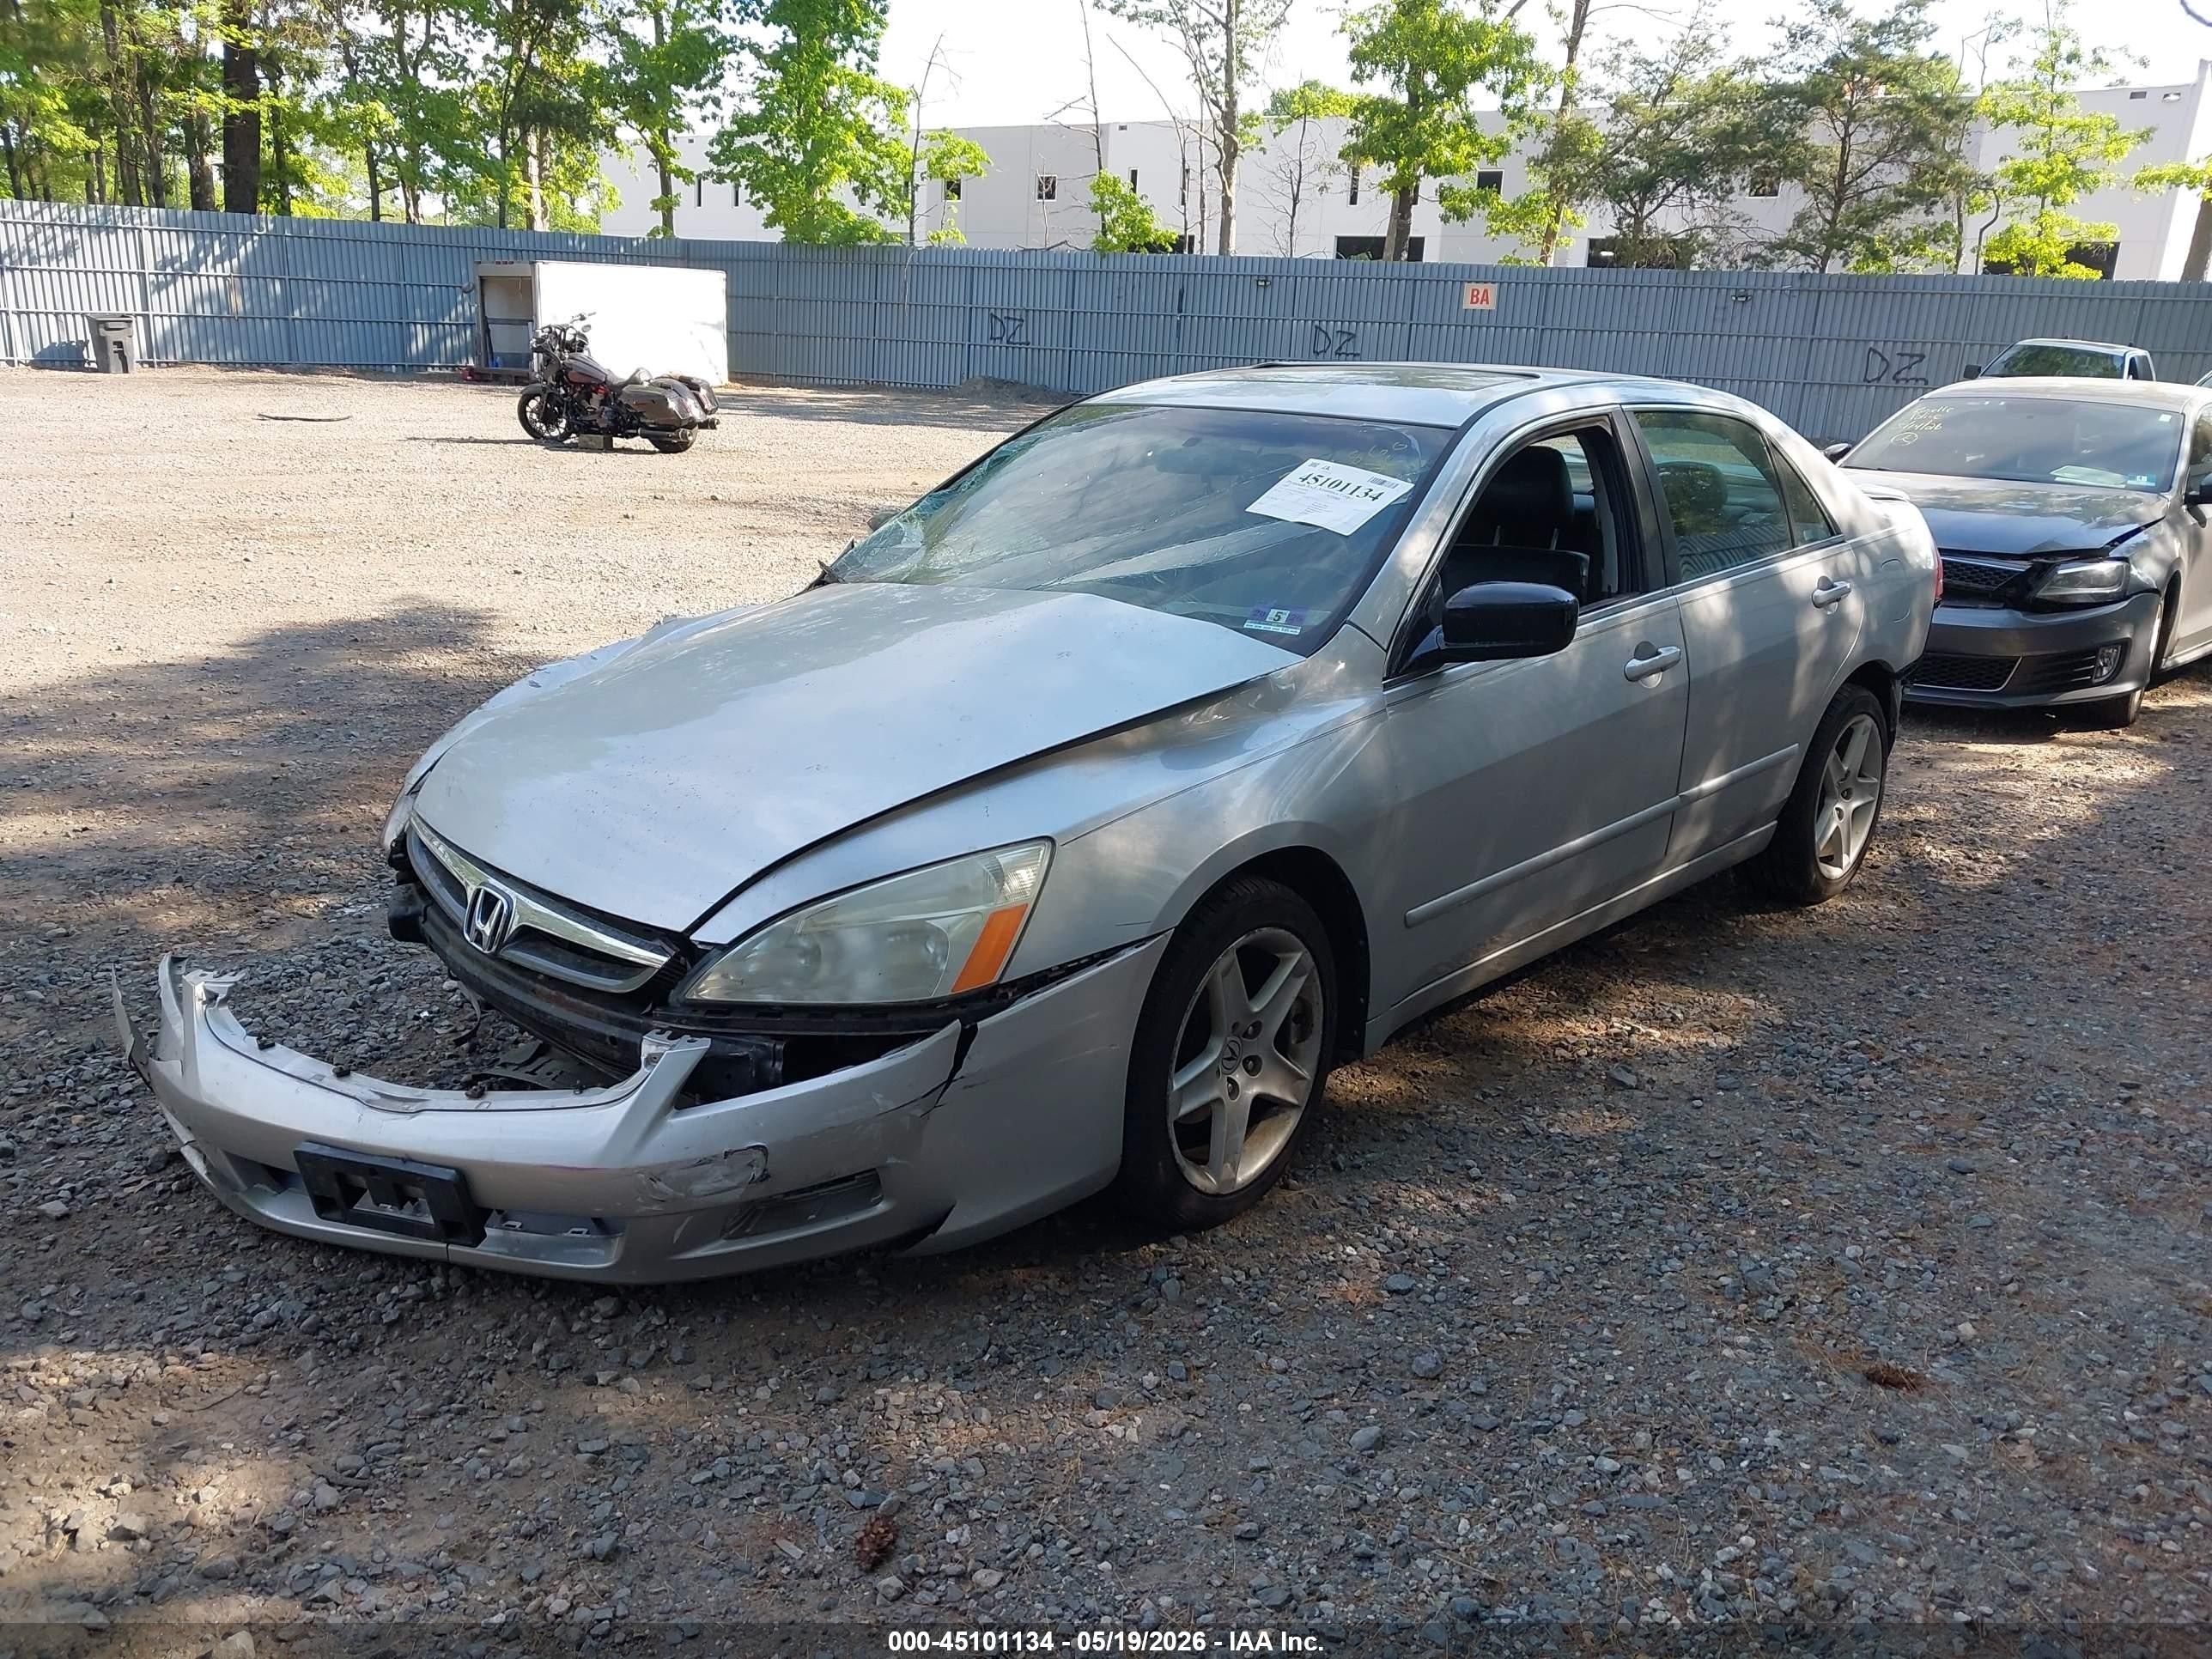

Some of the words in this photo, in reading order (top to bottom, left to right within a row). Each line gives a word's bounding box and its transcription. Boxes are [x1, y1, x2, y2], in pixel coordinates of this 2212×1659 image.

[1469, 288, 1490, 305] BA
[989, 312, 1030, 346] DZ
[1313, 325, 1361, 357] DZ
[1863, 347, 1929, 385] DZ
[1298, 472, 1385, 501] 45101134
[1273, 611, 1283, 622] 5
